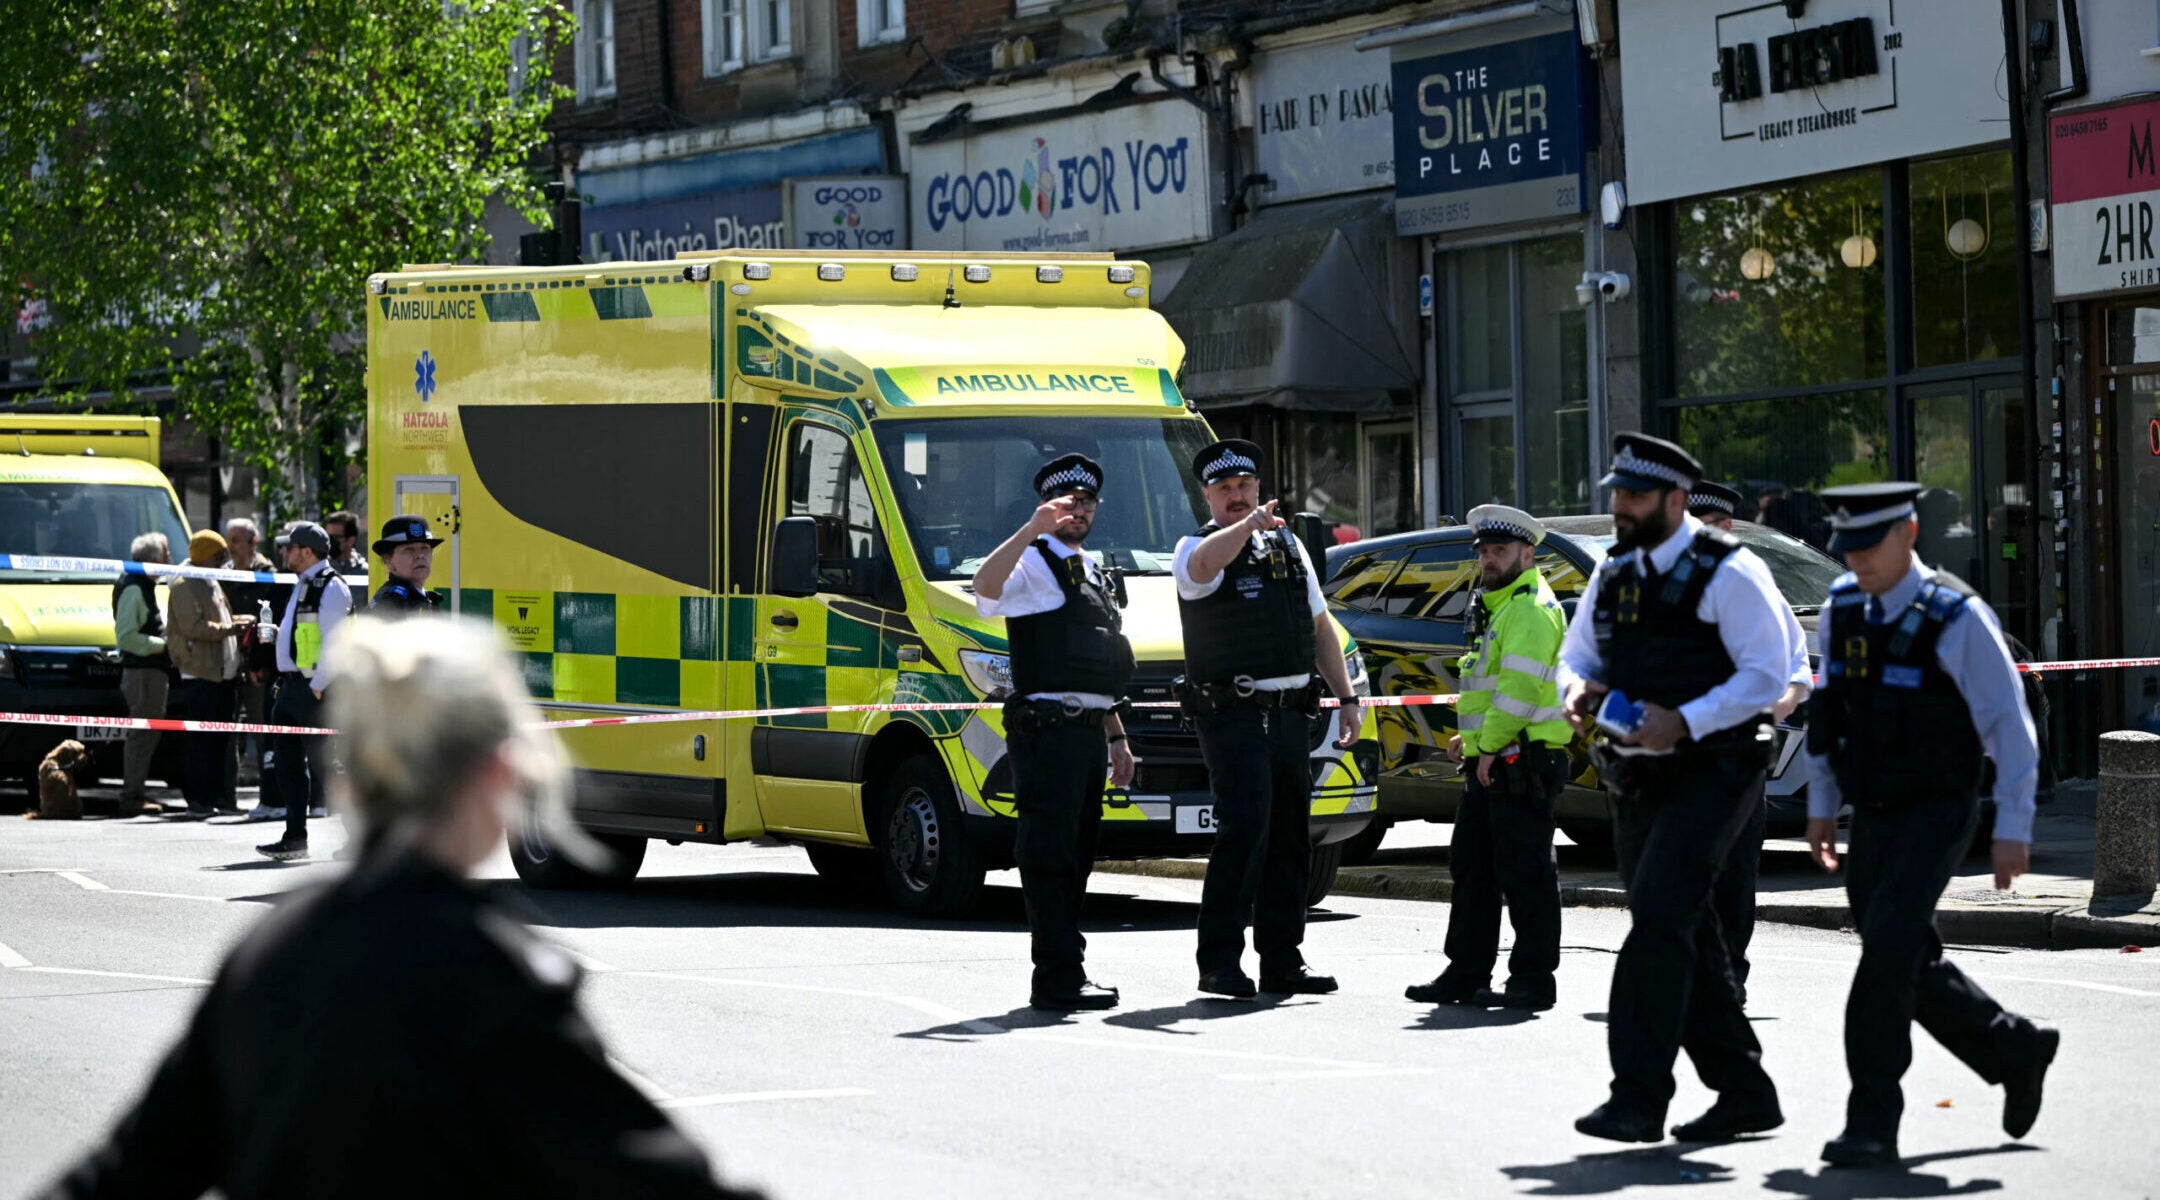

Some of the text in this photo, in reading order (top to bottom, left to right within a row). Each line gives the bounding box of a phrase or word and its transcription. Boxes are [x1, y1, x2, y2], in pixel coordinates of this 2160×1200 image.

[1454, 66, 1488, 92] THE
[1260, 98, 1300, 135] HAIR
[1309, 93, 1330, 127] BY
[1417, 73, 1548, 150] SILVER
[1758, 107, 1857, 142] LEGACY STEAKHOUSE
[1419, 138, 1551, 179] PLACE
[2127, 120, 2156, 180] M
[815, 187, 882, 205] GOOD
[927, 137, 1189, 232] GOOD FOR YOU
[617, 222, 707, 261] Victoria
[806, 229, 895, 250] FOR YOU
[2096, 201, 2155, 266] 2HR
[391, 300, 476, 321] AMBULANCE
[936, 374, 1135, 395] AMBULANCE
[403, 412, 449, 428] HATZOLA
